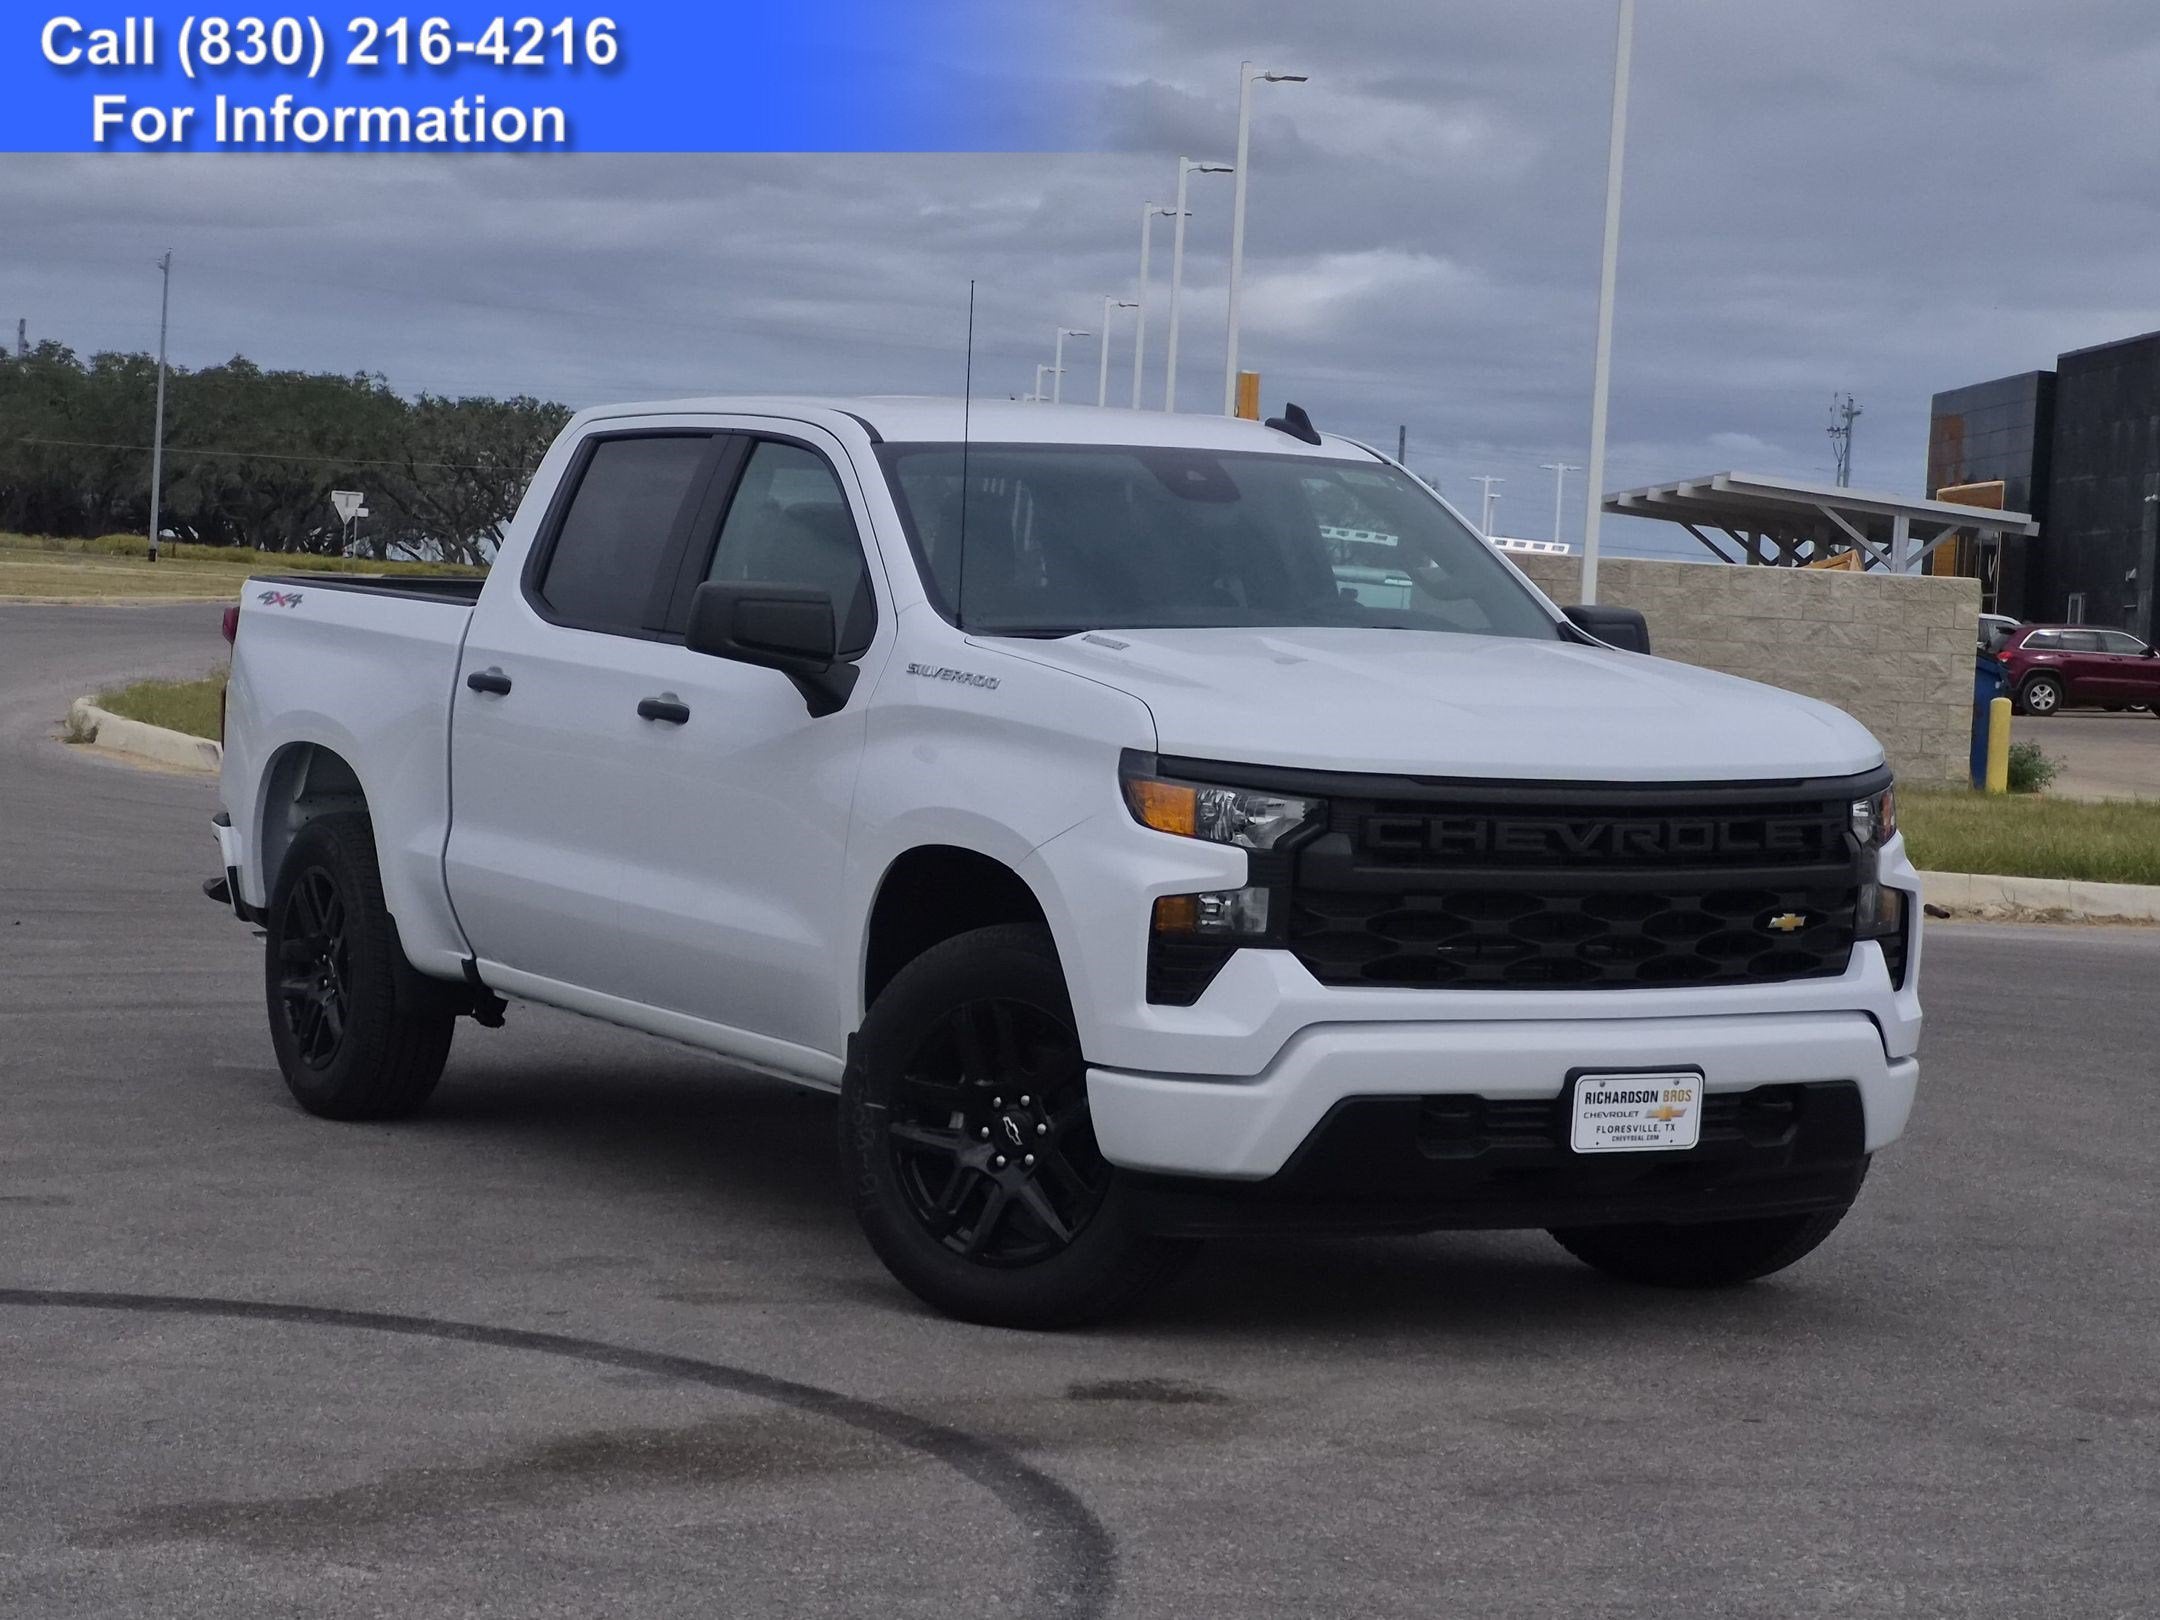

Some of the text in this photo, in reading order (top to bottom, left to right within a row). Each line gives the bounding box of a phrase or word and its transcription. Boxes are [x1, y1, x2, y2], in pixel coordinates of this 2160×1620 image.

[906, 662, 1001, 689] SILVERADO
[1366, 816, 1842, 855] CHEVROLET
[1585, 1089, 1692, 1104] RICHARDSON BROS
[1583, 1110, 1640, 1119] CHEVROLET
[1665, 1123, 1675, 1131] TX
